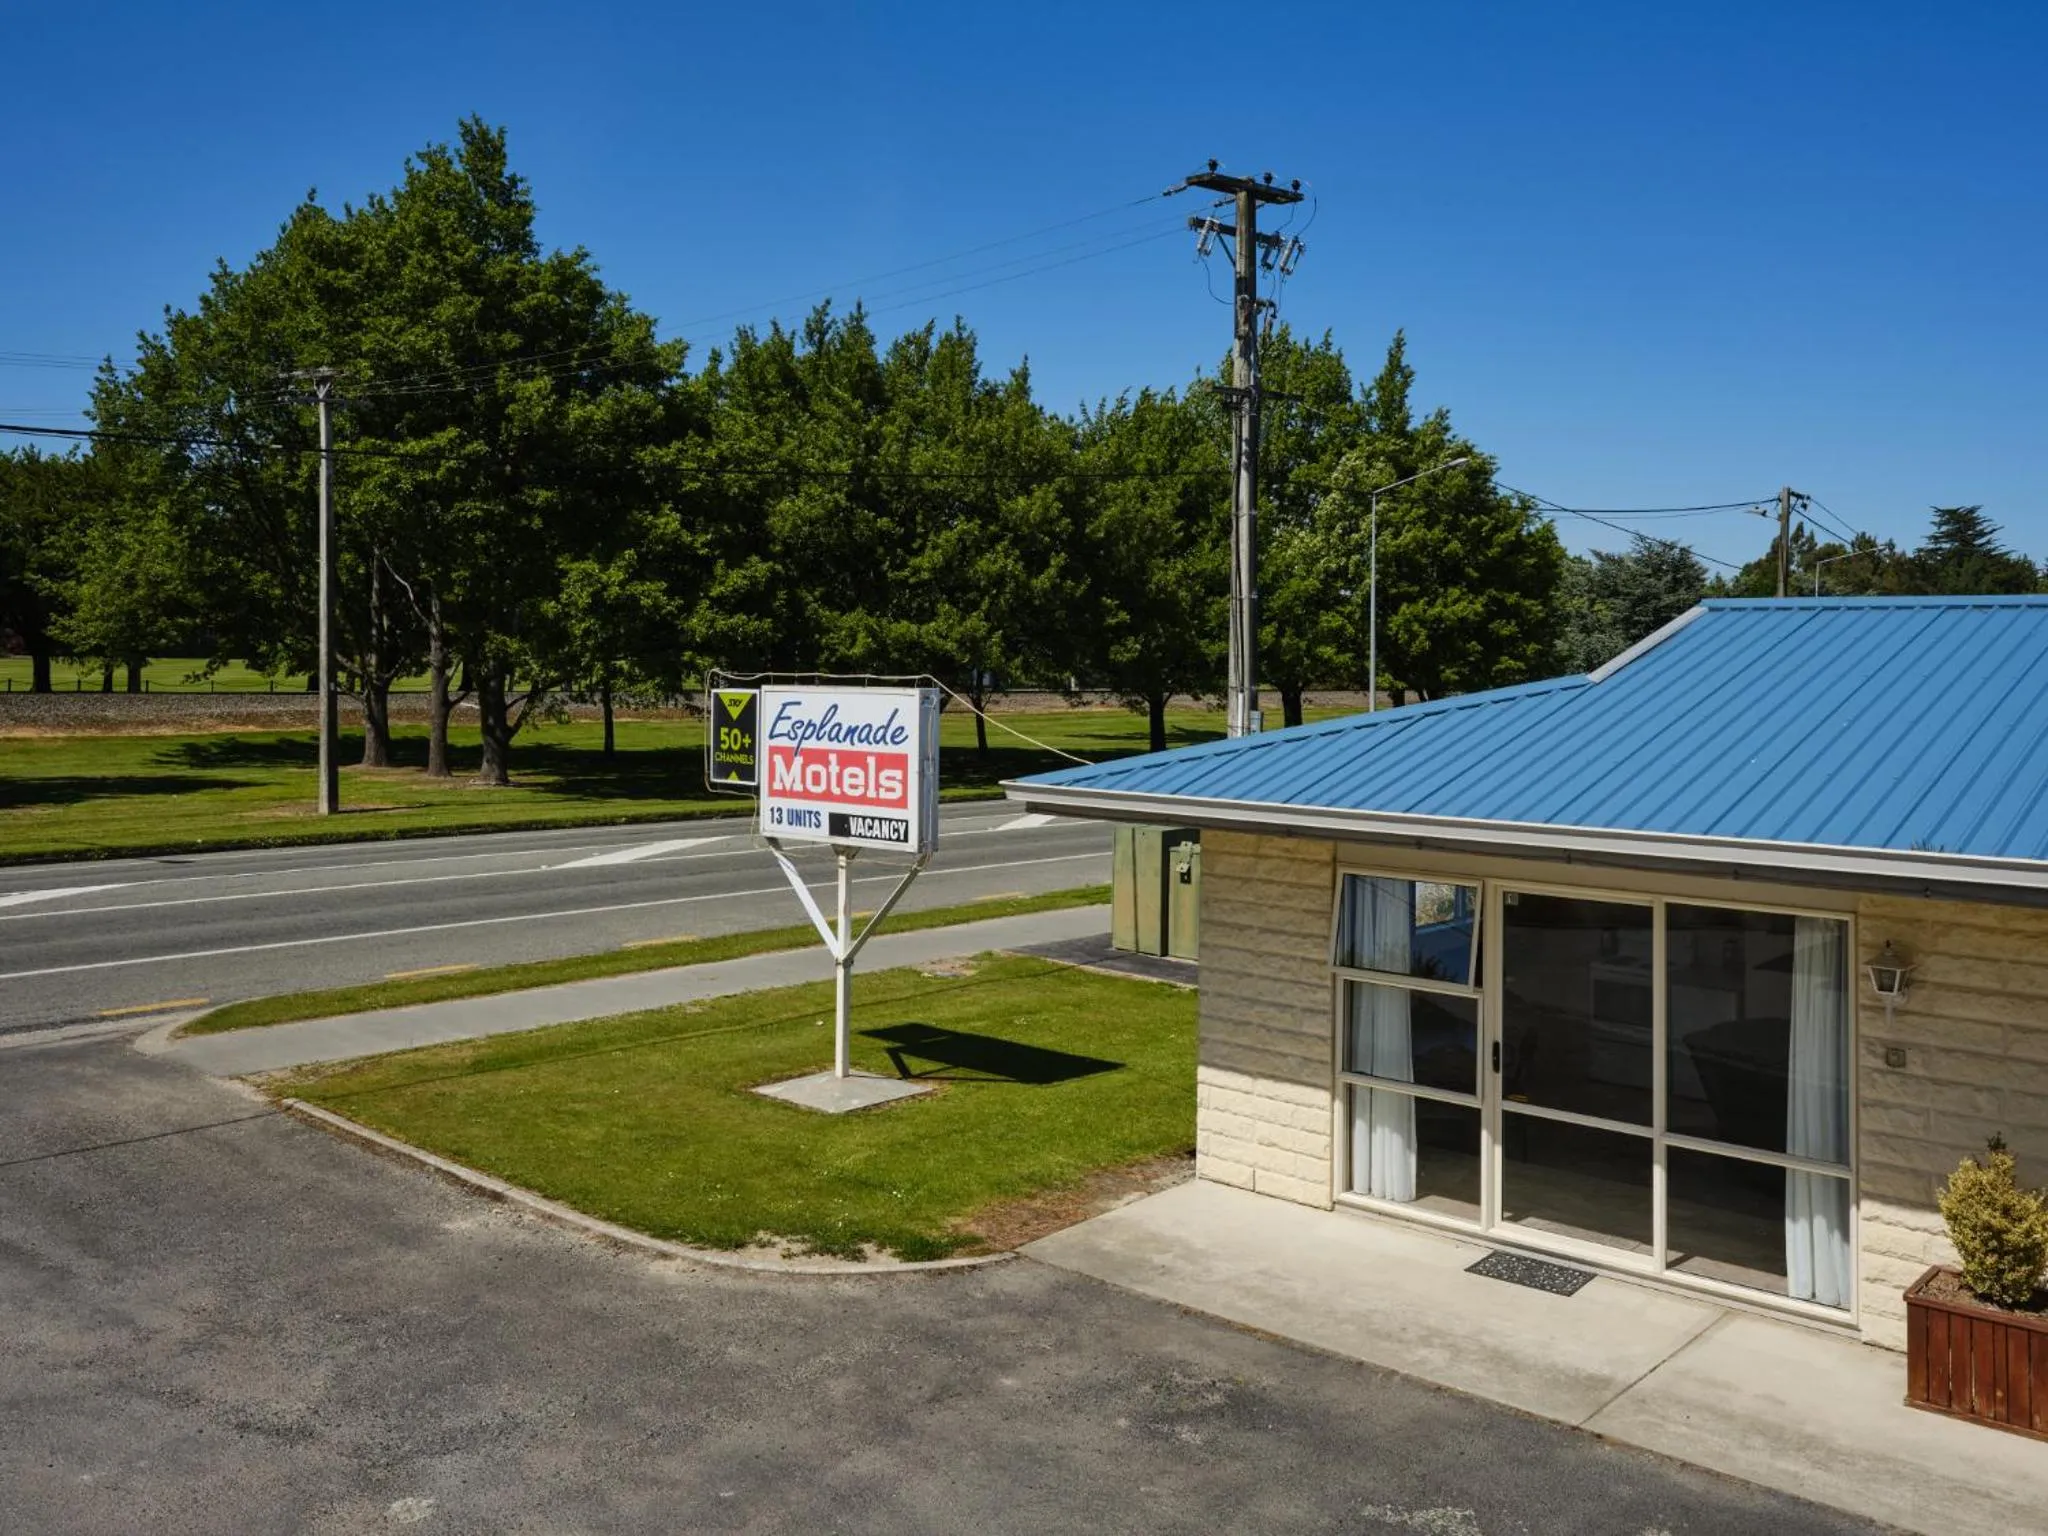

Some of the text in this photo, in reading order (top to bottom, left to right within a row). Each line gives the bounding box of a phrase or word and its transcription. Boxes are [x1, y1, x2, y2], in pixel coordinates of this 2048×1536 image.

[720, 727, 752, 751] 50+
[768, 701, 908, 756] Esplanade
[715, 752, 754, 765] CHANNELS
[773, 753, 903, 800] Motels
[770, 806, 822, 828] 13 UNITS
[849, 816, 906, 840] VACANCY
